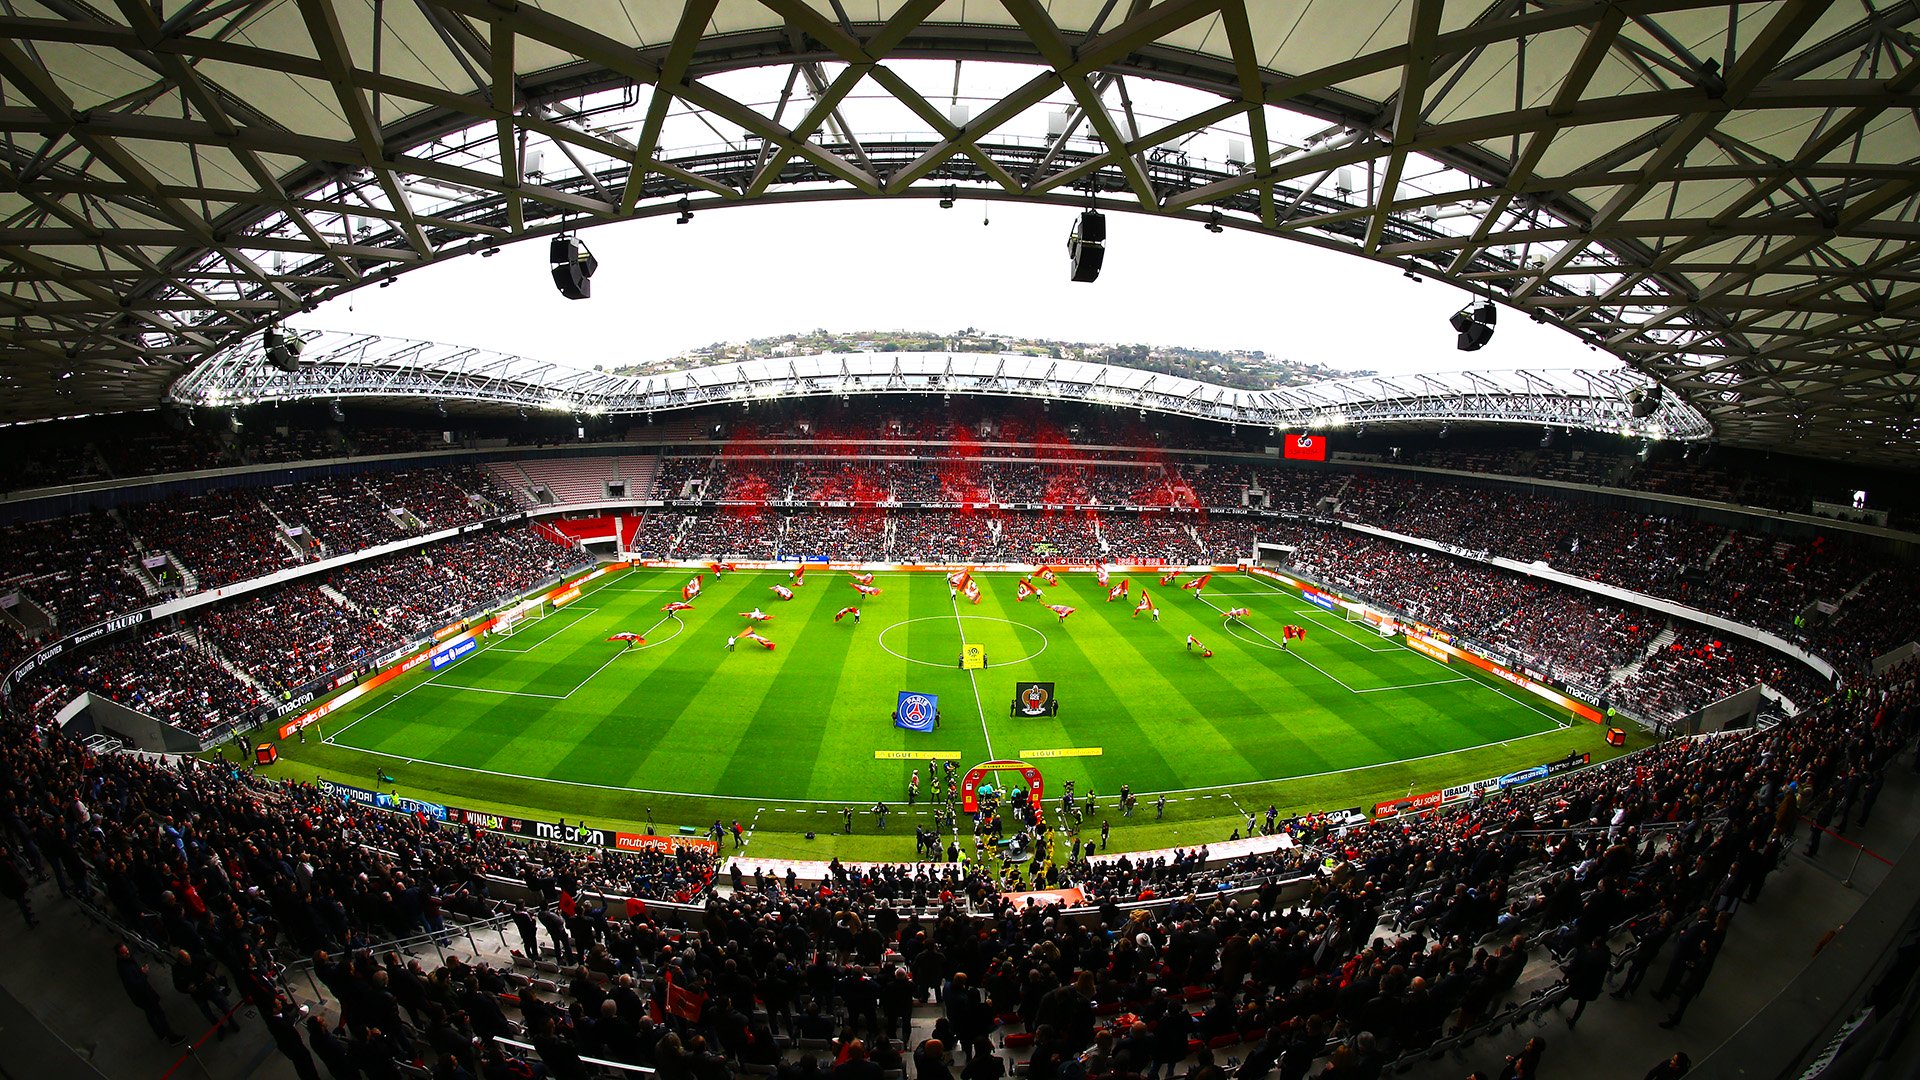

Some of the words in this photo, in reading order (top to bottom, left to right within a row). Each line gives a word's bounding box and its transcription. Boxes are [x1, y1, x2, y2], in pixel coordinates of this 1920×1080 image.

[74, 628, 104, 645] Brasserie
[106, 613, 144, 633] MAURO
[1492, 667, 1517, 685] mutuelles
[277, 692, 314, 717] macron
[906, 696, 928, 706] PARIS
[1565, 685, 1600, 707] macron
[1444, 785, 1470, 798] UBALDI
[1473, 778, 1498, 791] UBALDI
[335, 785, 373, 802] HYUNDAI
[1412, 796, 1423, 808] du
[1423, 793, 1441, 806] soleil
[409, 801, 421, 812] DE
[423, 805, 444, 818] NICE
[619, 837, 668, 850] mutuelles
